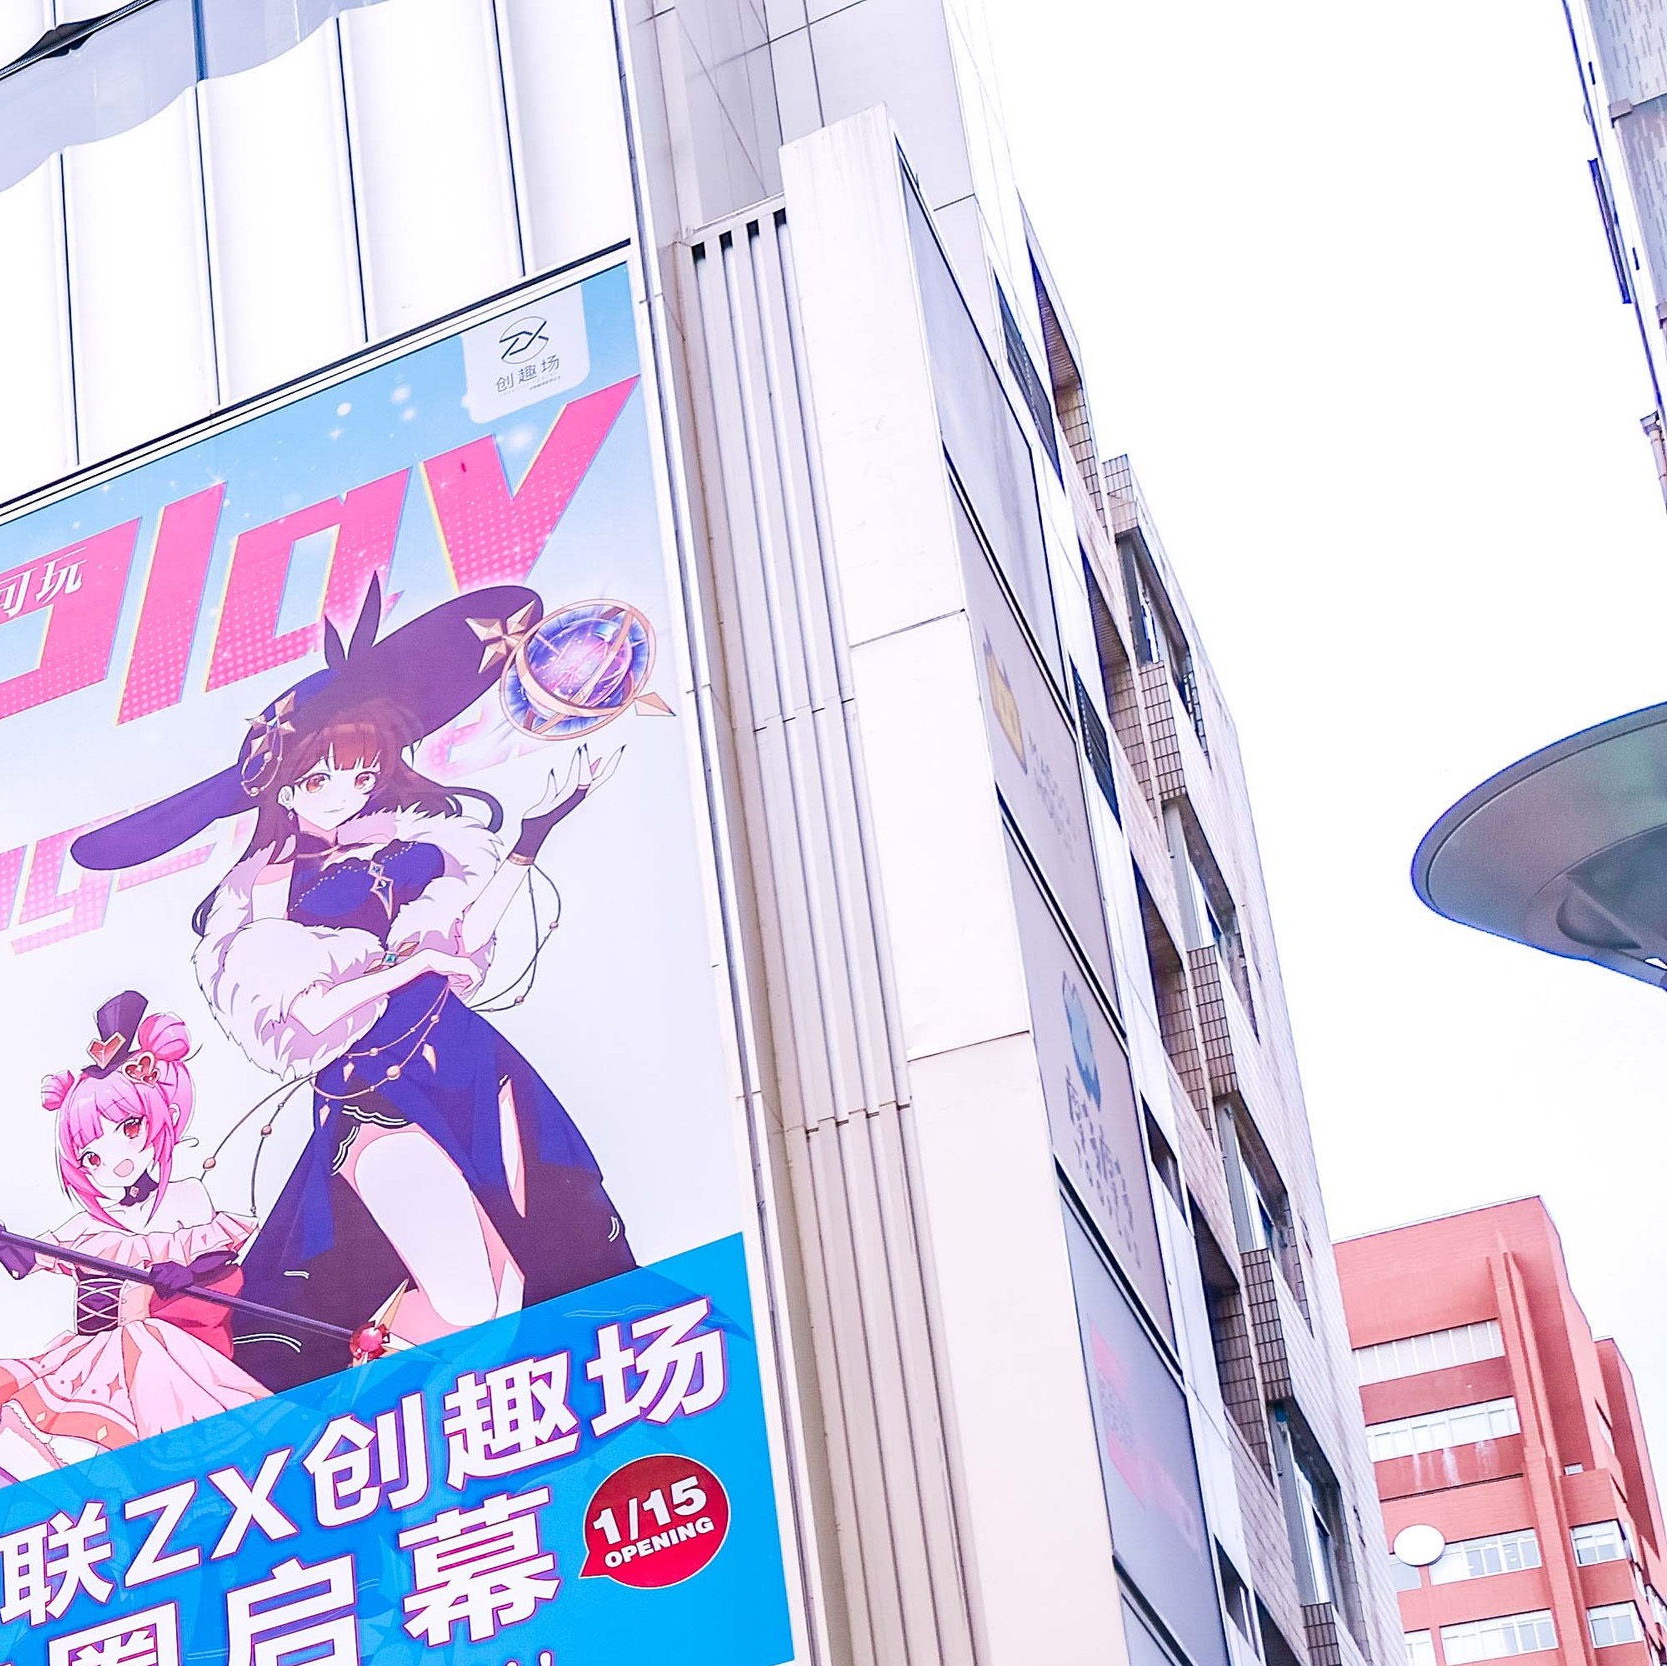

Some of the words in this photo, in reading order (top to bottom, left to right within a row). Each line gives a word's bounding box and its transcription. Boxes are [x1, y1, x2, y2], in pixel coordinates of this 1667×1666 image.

[495, 354, 560, 393] 创趣场
[592, 1475, 707, 1545] 1/15
[604, 1516, 715, 1568] OPENING
